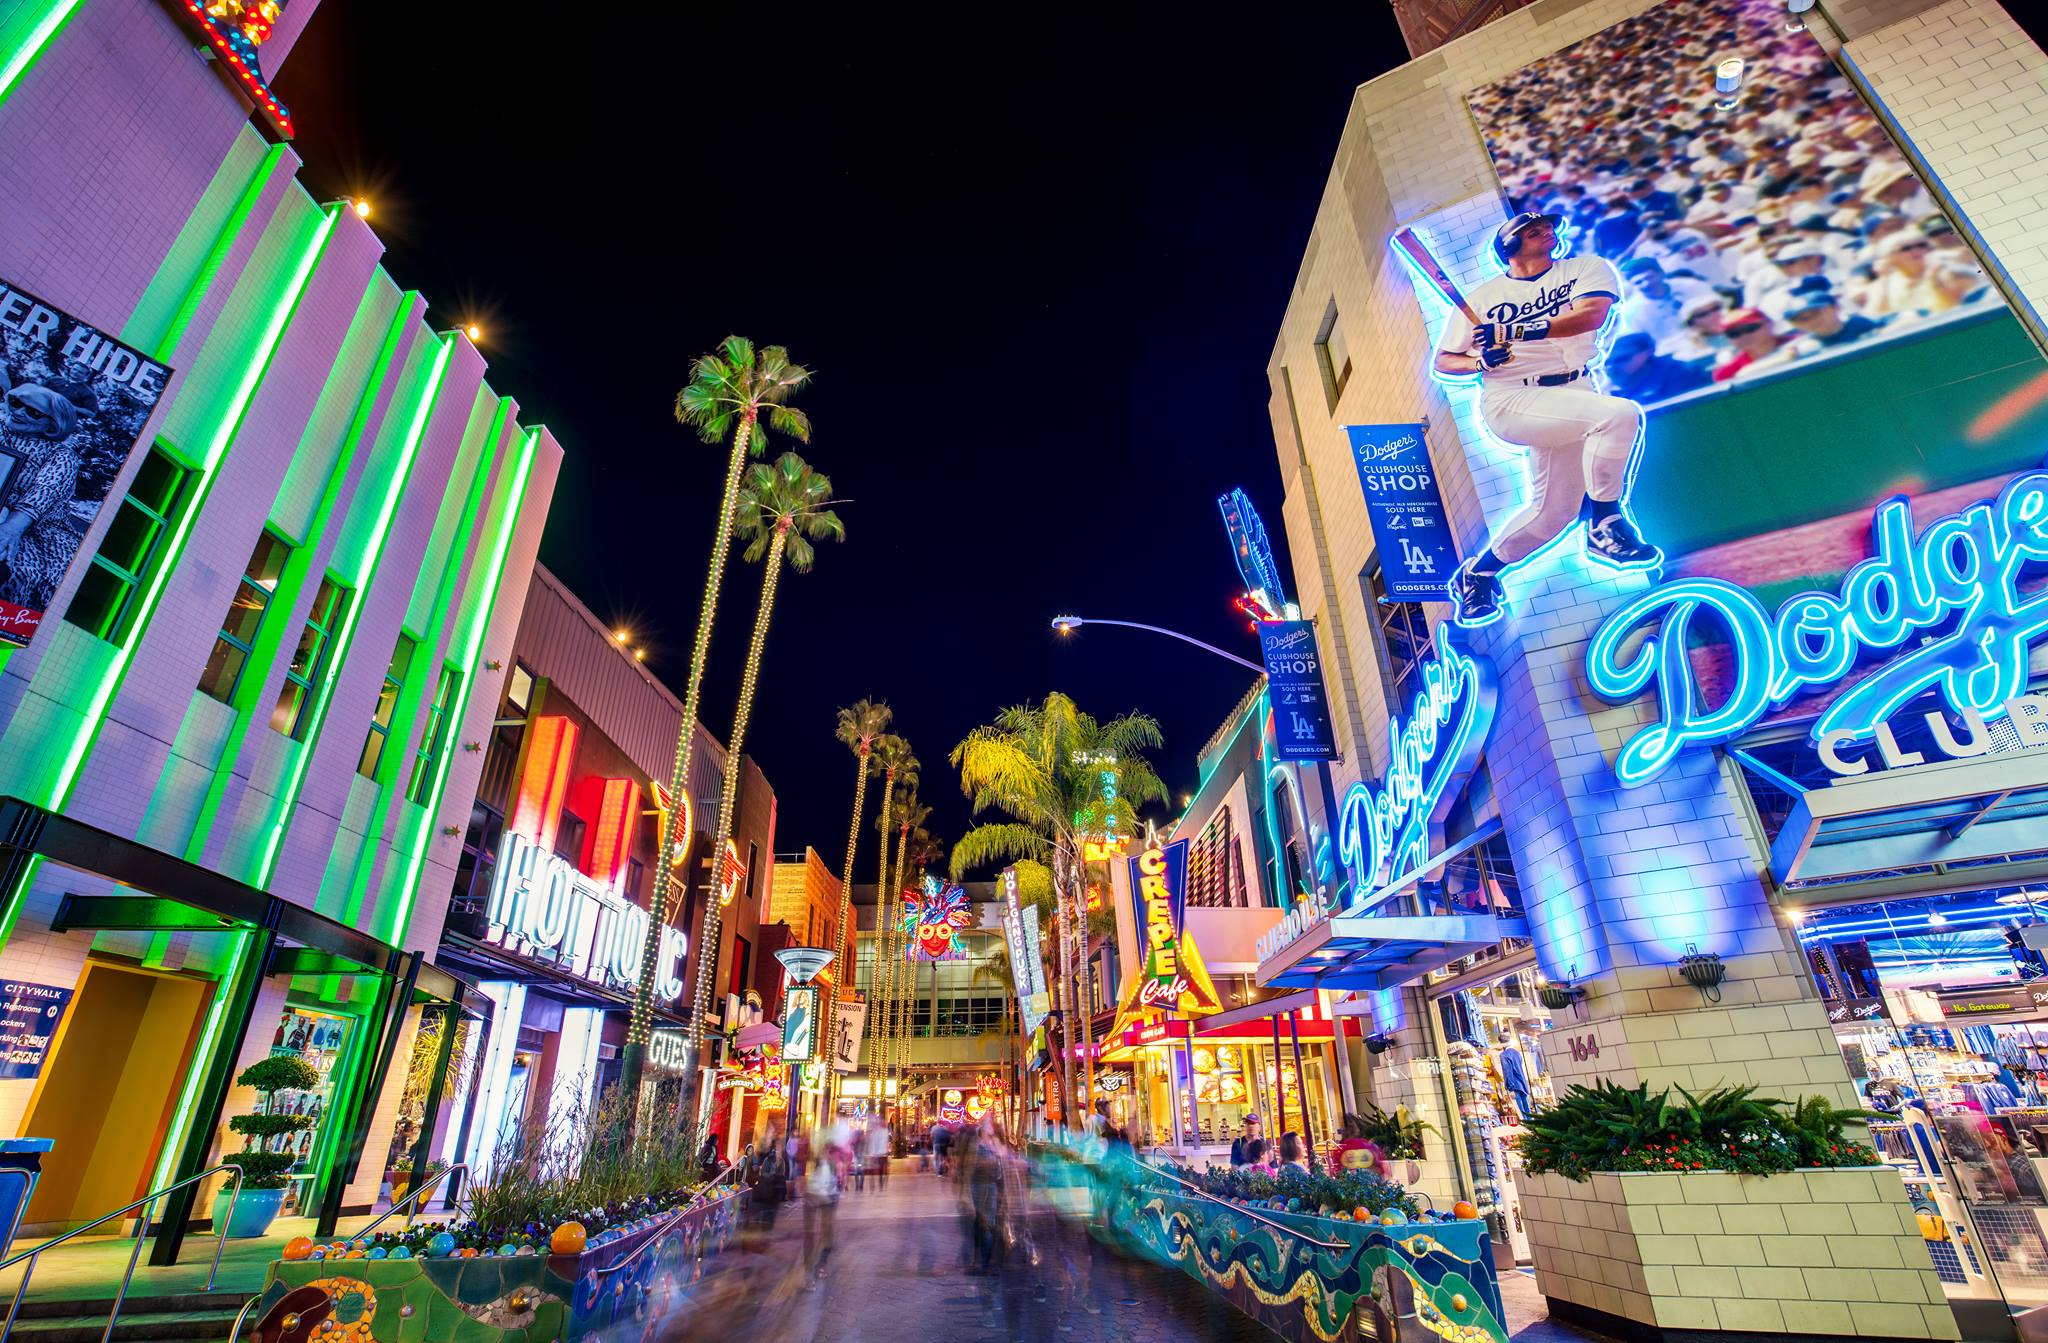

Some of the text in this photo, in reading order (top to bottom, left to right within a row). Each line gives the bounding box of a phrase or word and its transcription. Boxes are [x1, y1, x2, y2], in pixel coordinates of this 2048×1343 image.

[0, 284, 164, 397] ER HIDE
[1360, 434, 1418, 462] Dodgers
[1363, 465, 1428, 473] CLUBHOUSE
[1366, 474, 1431, 491] SHOP
[1398, 538, 1436, 574] LA
[0, 606, 39, 626] y-Ban
[1265, 628, 1310, 651] Dodgers
[1586, 470, 2048, 788] Dodge
[1267, 652, 1315, 660] CLUBHOUSE
[1269, 661, 1316, 674] SHOP
[1290, 711, 1316, 739] LA
[1817, 694, 2048, 777] CLUB
[1340, 620, 1479, 908] Dodgers
[486, 831, 687, 1000] HOT TOIC
[1139, 849, 1177, 976] CREPE
[1256, 885, 1330, 964] CLUBHOUSE
[1004, 871, 1028, 989] WOLFGANG PUCK
[5, 984, 62, 999] CITYWALK
[1140, 974, 1188, 1005] Cafe
[2033, 992, 2048, 1004] Do
[3, 1002, 42, 1014] Restrooms
[837, 1003, 862, 1012] TENSION
[1854, 1002, 1882, 1018] Dodgers
[1953, 1004, 1966, 1012] No
[1968, 1003, 2010, 1012] Gateway
[0, 1034, 19, 1044] rking
[648, 1031, 689, 1070] GUES
[1567, 1033, 1600, 1063] 164
[0, 1051, 12, 1060] ing
